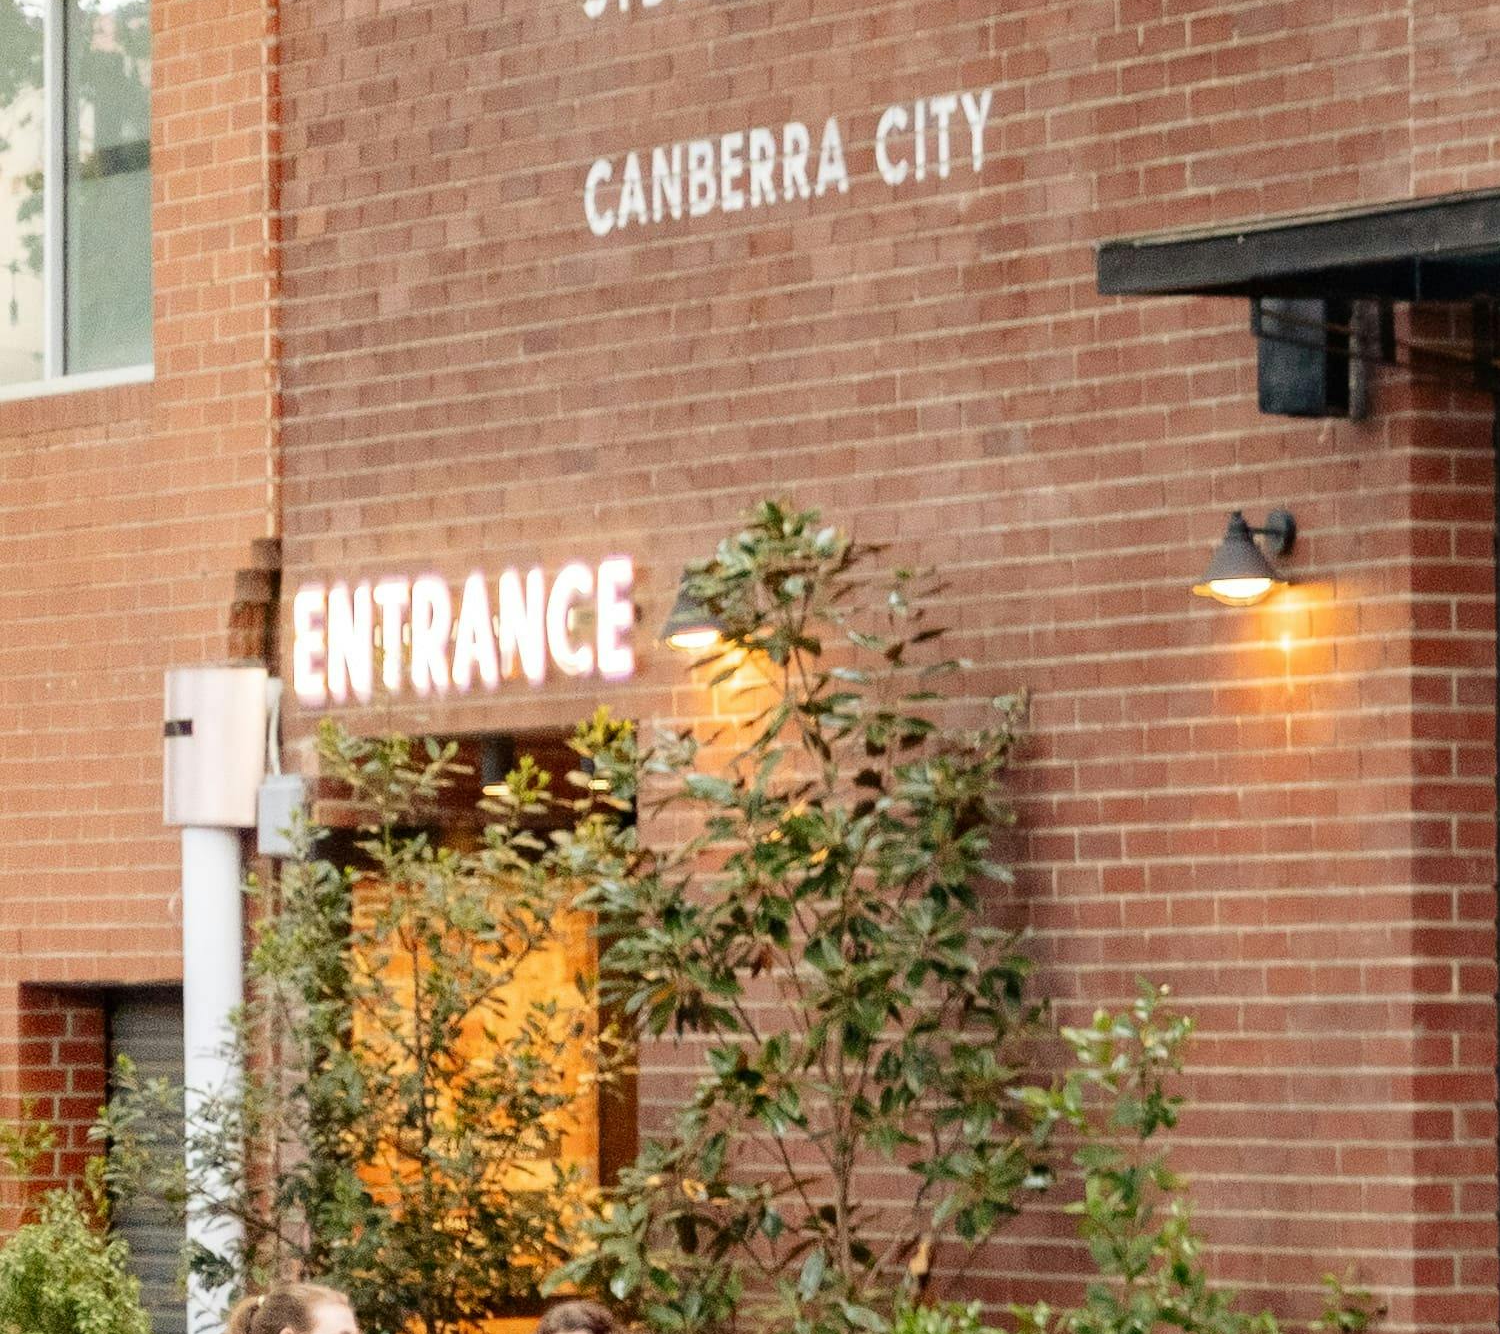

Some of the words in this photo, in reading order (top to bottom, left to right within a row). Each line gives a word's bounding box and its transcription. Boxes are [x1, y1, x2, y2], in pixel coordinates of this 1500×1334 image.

[584, 116, 850, 236] CANBERRA
[875, 89, 992, 186] CITY
[293, 555, 637, 705] ENTRANCE
